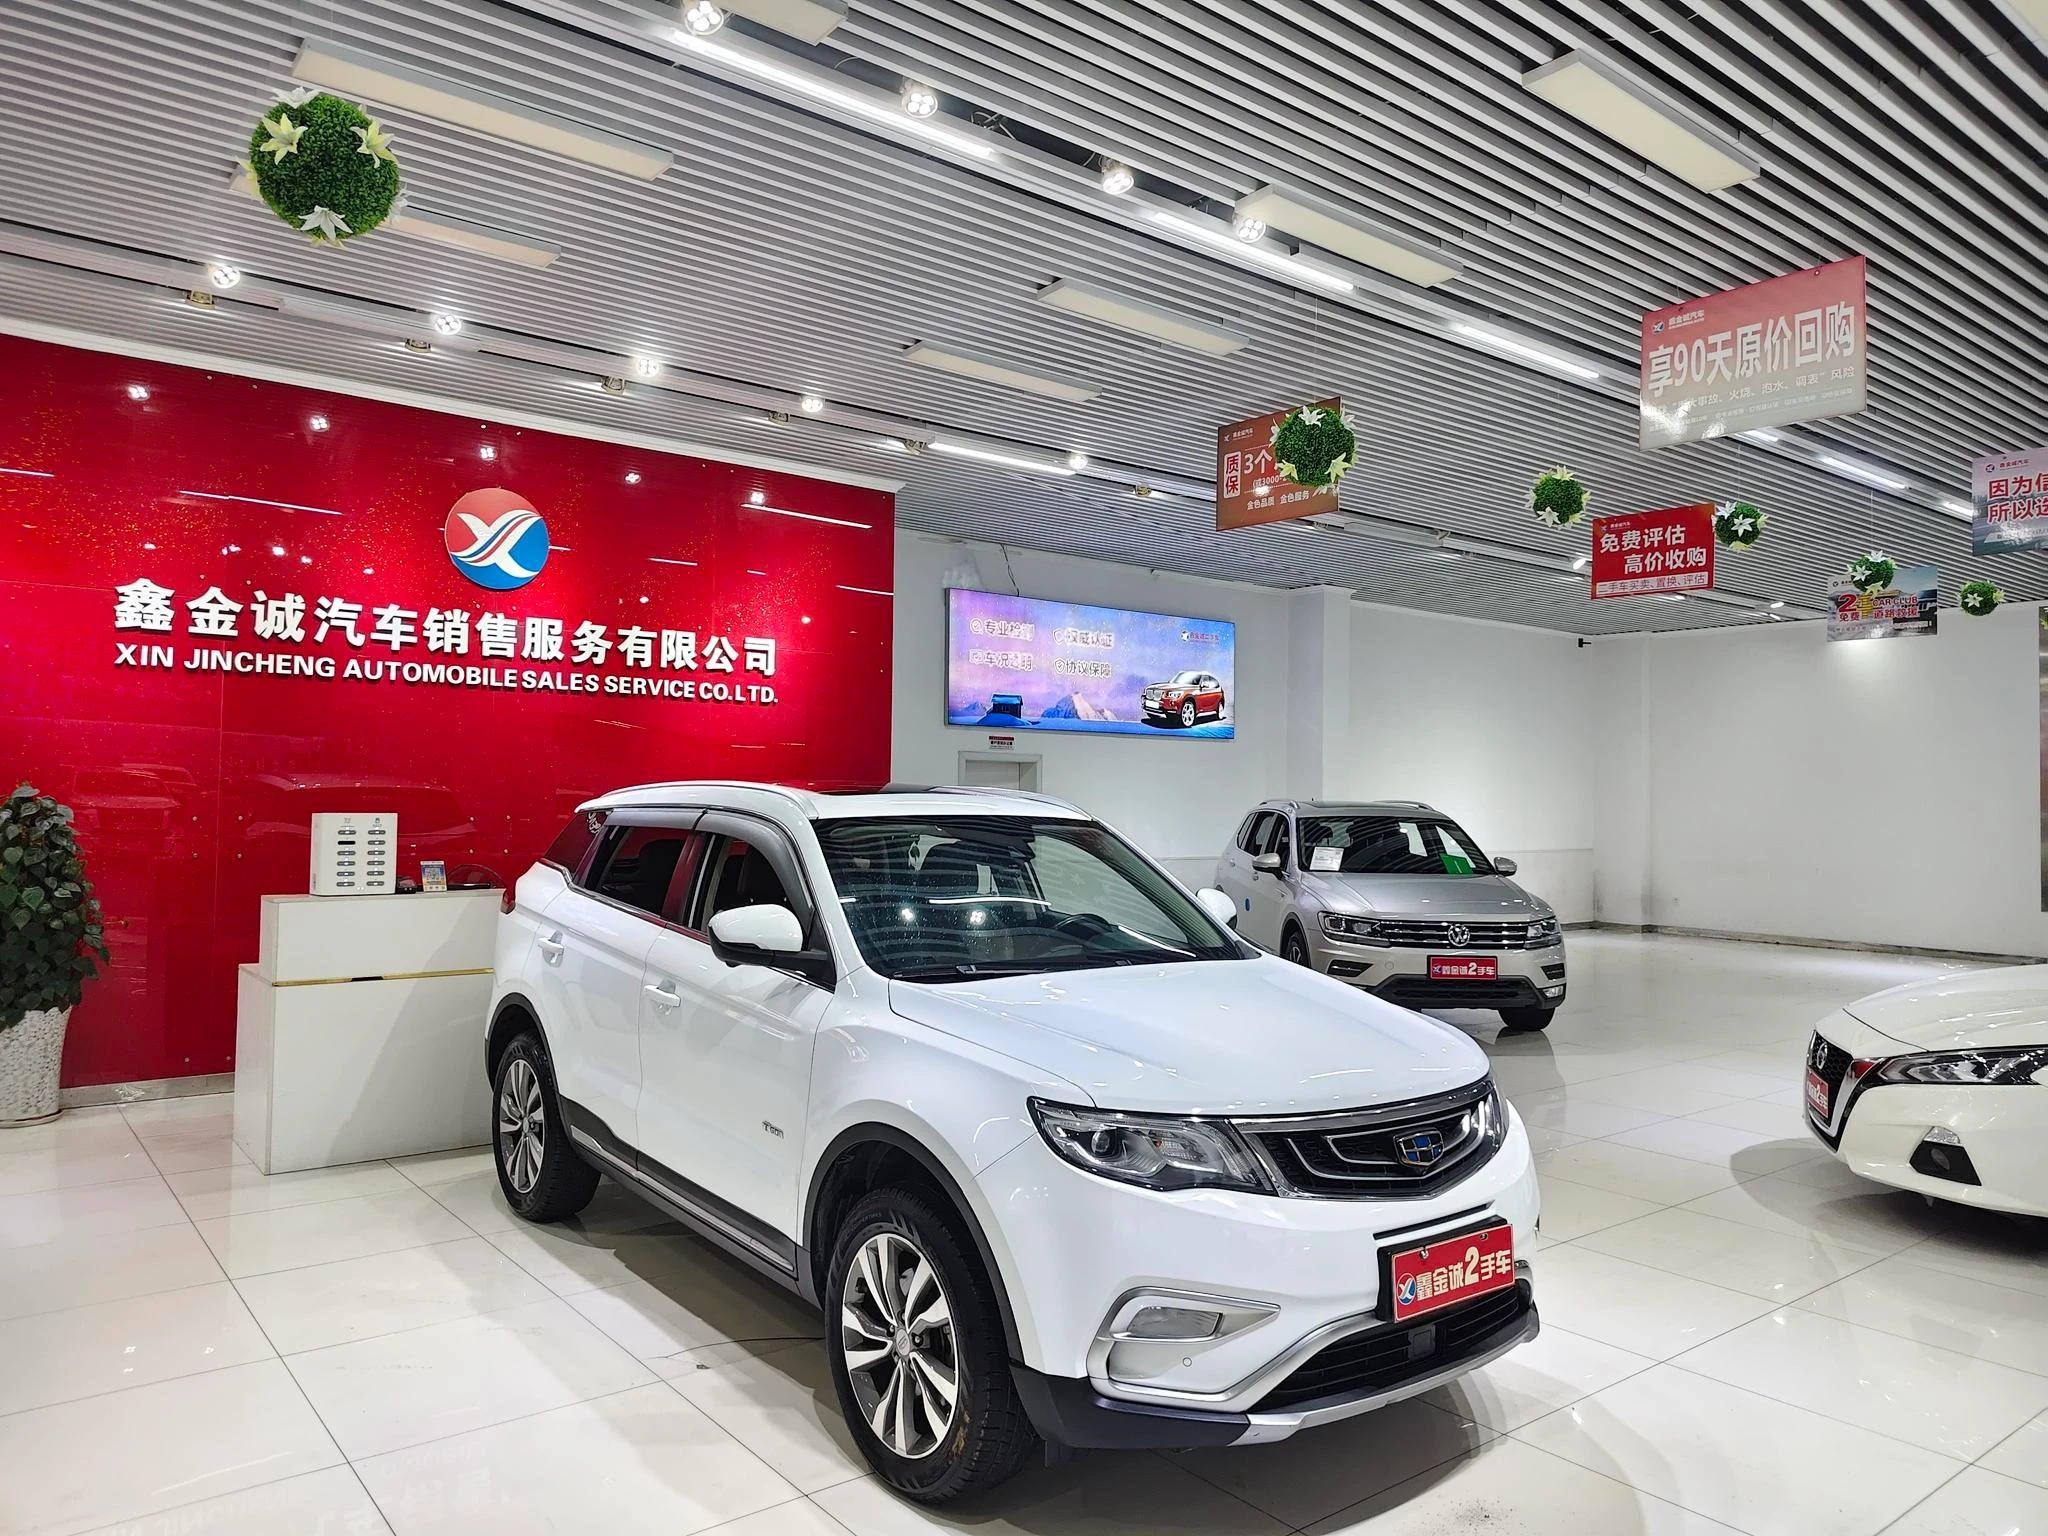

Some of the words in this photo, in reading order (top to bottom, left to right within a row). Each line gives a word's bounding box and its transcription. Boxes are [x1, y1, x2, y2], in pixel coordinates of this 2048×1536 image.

[1648, 301, 1855, 397] 享90天原价回购
[1830, 366, 1856, 381] 风险
[1226, 454, 1239, 495] 质保
[1244, 449, 1278, 474] 3个
[1600, 525, 1686, 553] 免费评估
[1624, 546, 1707, 575] 高价收购
[1872, 599, 1891, 607] CAR
[1893, 596, 1918, 605] CLUB
[114, 577, 779, 676] 鑫金诚汽车销售服务有限公司
[114, 643, 175, 668] XIN
[184, 648, 336, 679] JINCHENG
[342, 658, 518, 688] AUTOMOBILE
[521, 669, 600, 693] SALES
[603, 674, 696, 699] SERVICE
[1416, 1246, 1511, 1301] 鑫金诚2手车
